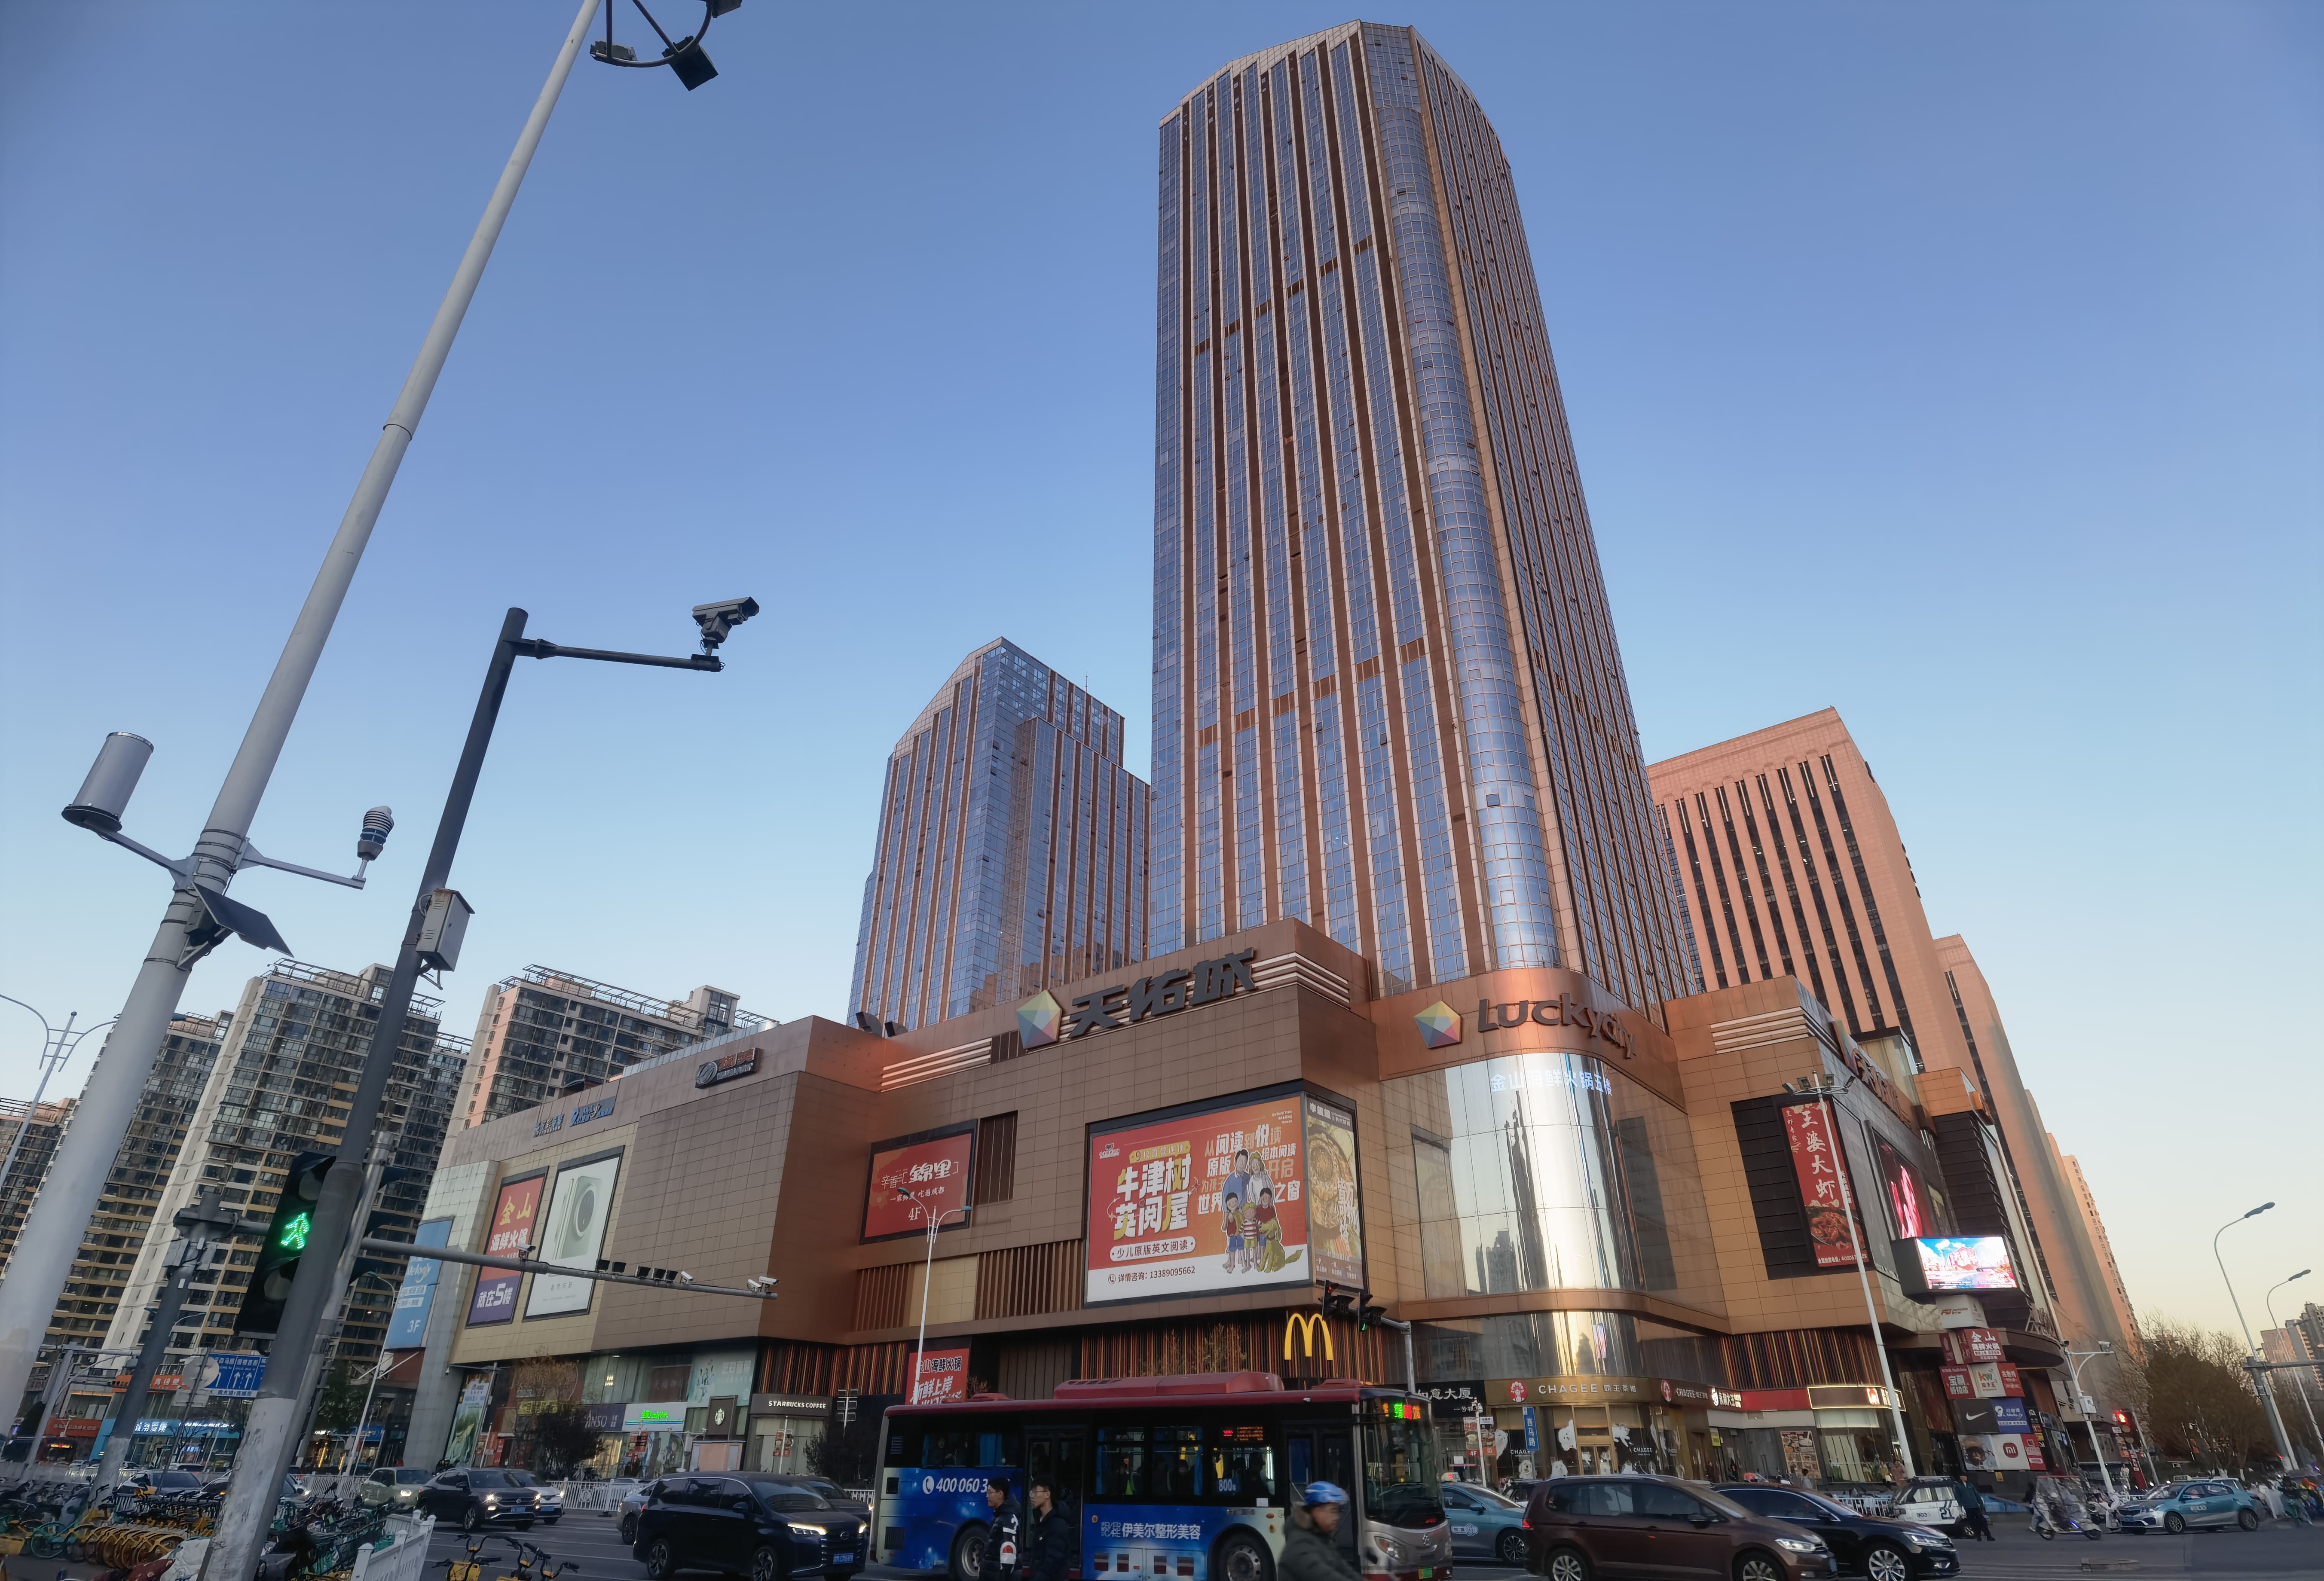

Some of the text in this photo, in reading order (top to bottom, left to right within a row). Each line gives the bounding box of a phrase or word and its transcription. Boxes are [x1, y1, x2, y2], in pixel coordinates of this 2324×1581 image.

[1067, 947, 1257, 1038] 天佑城
[1491, 1068, 1612, 1096] 金山海鲜火锅五楼
[1205, 1123, 1281, 1157] 从阅读到悦读
[1262, 1143, 1296, 1160] 绘本阅读
[1801, 1110, 1835, 1199] 王婆大虾
[1117, 1153, 1191, 1202] 牛津树
[1207, 1155, 1231, 1178] 原版
[1268, 1158, 1294, 1179] 开启
[1274, 1180, 1300, 1203] 之窗
[499, 1192, 532, 1225] 金山
[908, 1206, 921, 1221] 4F
[1198, 1192, 1222, 1215] 世界
[1114, 1191, 1189, 1241] 英阅屋
[490, 1228, 528, 1252] 海鲜火锅
[1117, 1239, 1188, 1259] 少儿原版英文阅读
[1150, 1266, 1196, 1279] 13389095662
[407, 1319, 421, 1333] 3F
[1972, 1331, 1996, 1342] 金山
[1538, 1384, 1636, 1394] CHAGEE 霸王茶姬
[1526, 1418, 1536, 1447] 西马路
[1122, 1522, 1201, 1540] 伊美尔整形美容
